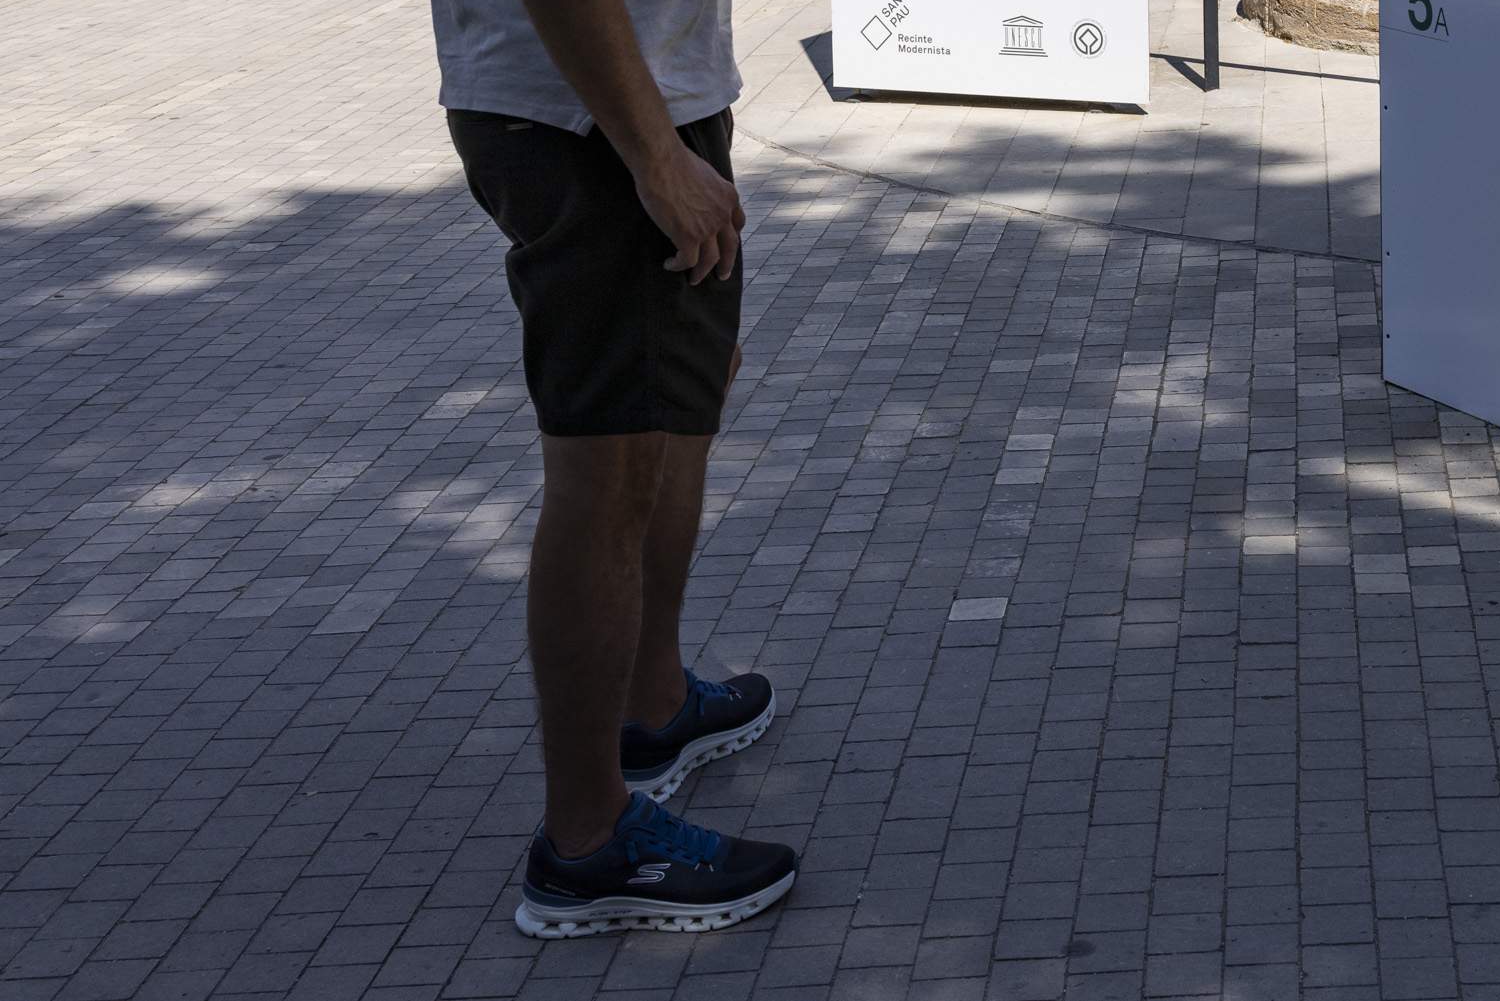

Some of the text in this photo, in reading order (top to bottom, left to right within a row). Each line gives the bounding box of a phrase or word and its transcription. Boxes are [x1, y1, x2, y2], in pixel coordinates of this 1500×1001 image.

[889, 5, 910, 28] PAU
[898, 33, 933, 44] Recinte
[1004, 28, 1042, 48] UNESCO
[898, 45, 951, 55] Modernista
